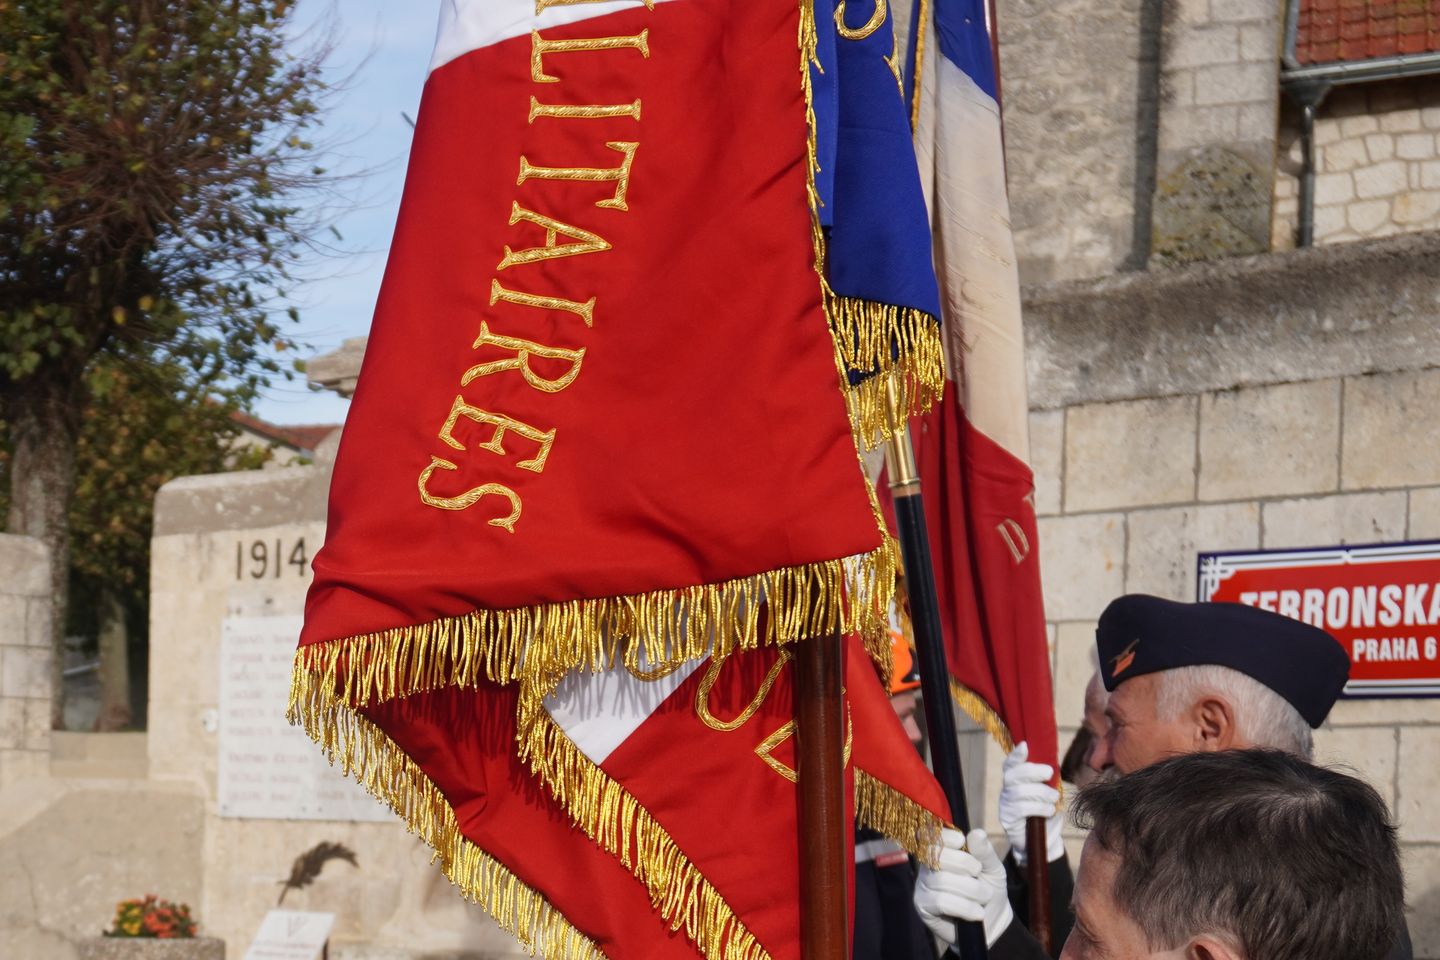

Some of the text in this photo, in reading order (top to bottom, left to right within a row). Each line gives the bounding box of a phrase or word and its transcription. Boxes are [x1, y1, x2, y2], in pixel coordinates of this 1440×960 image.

[236, 537, 308, 581] 1914
[1353, 635, 1438, 663] PRAHA 6
